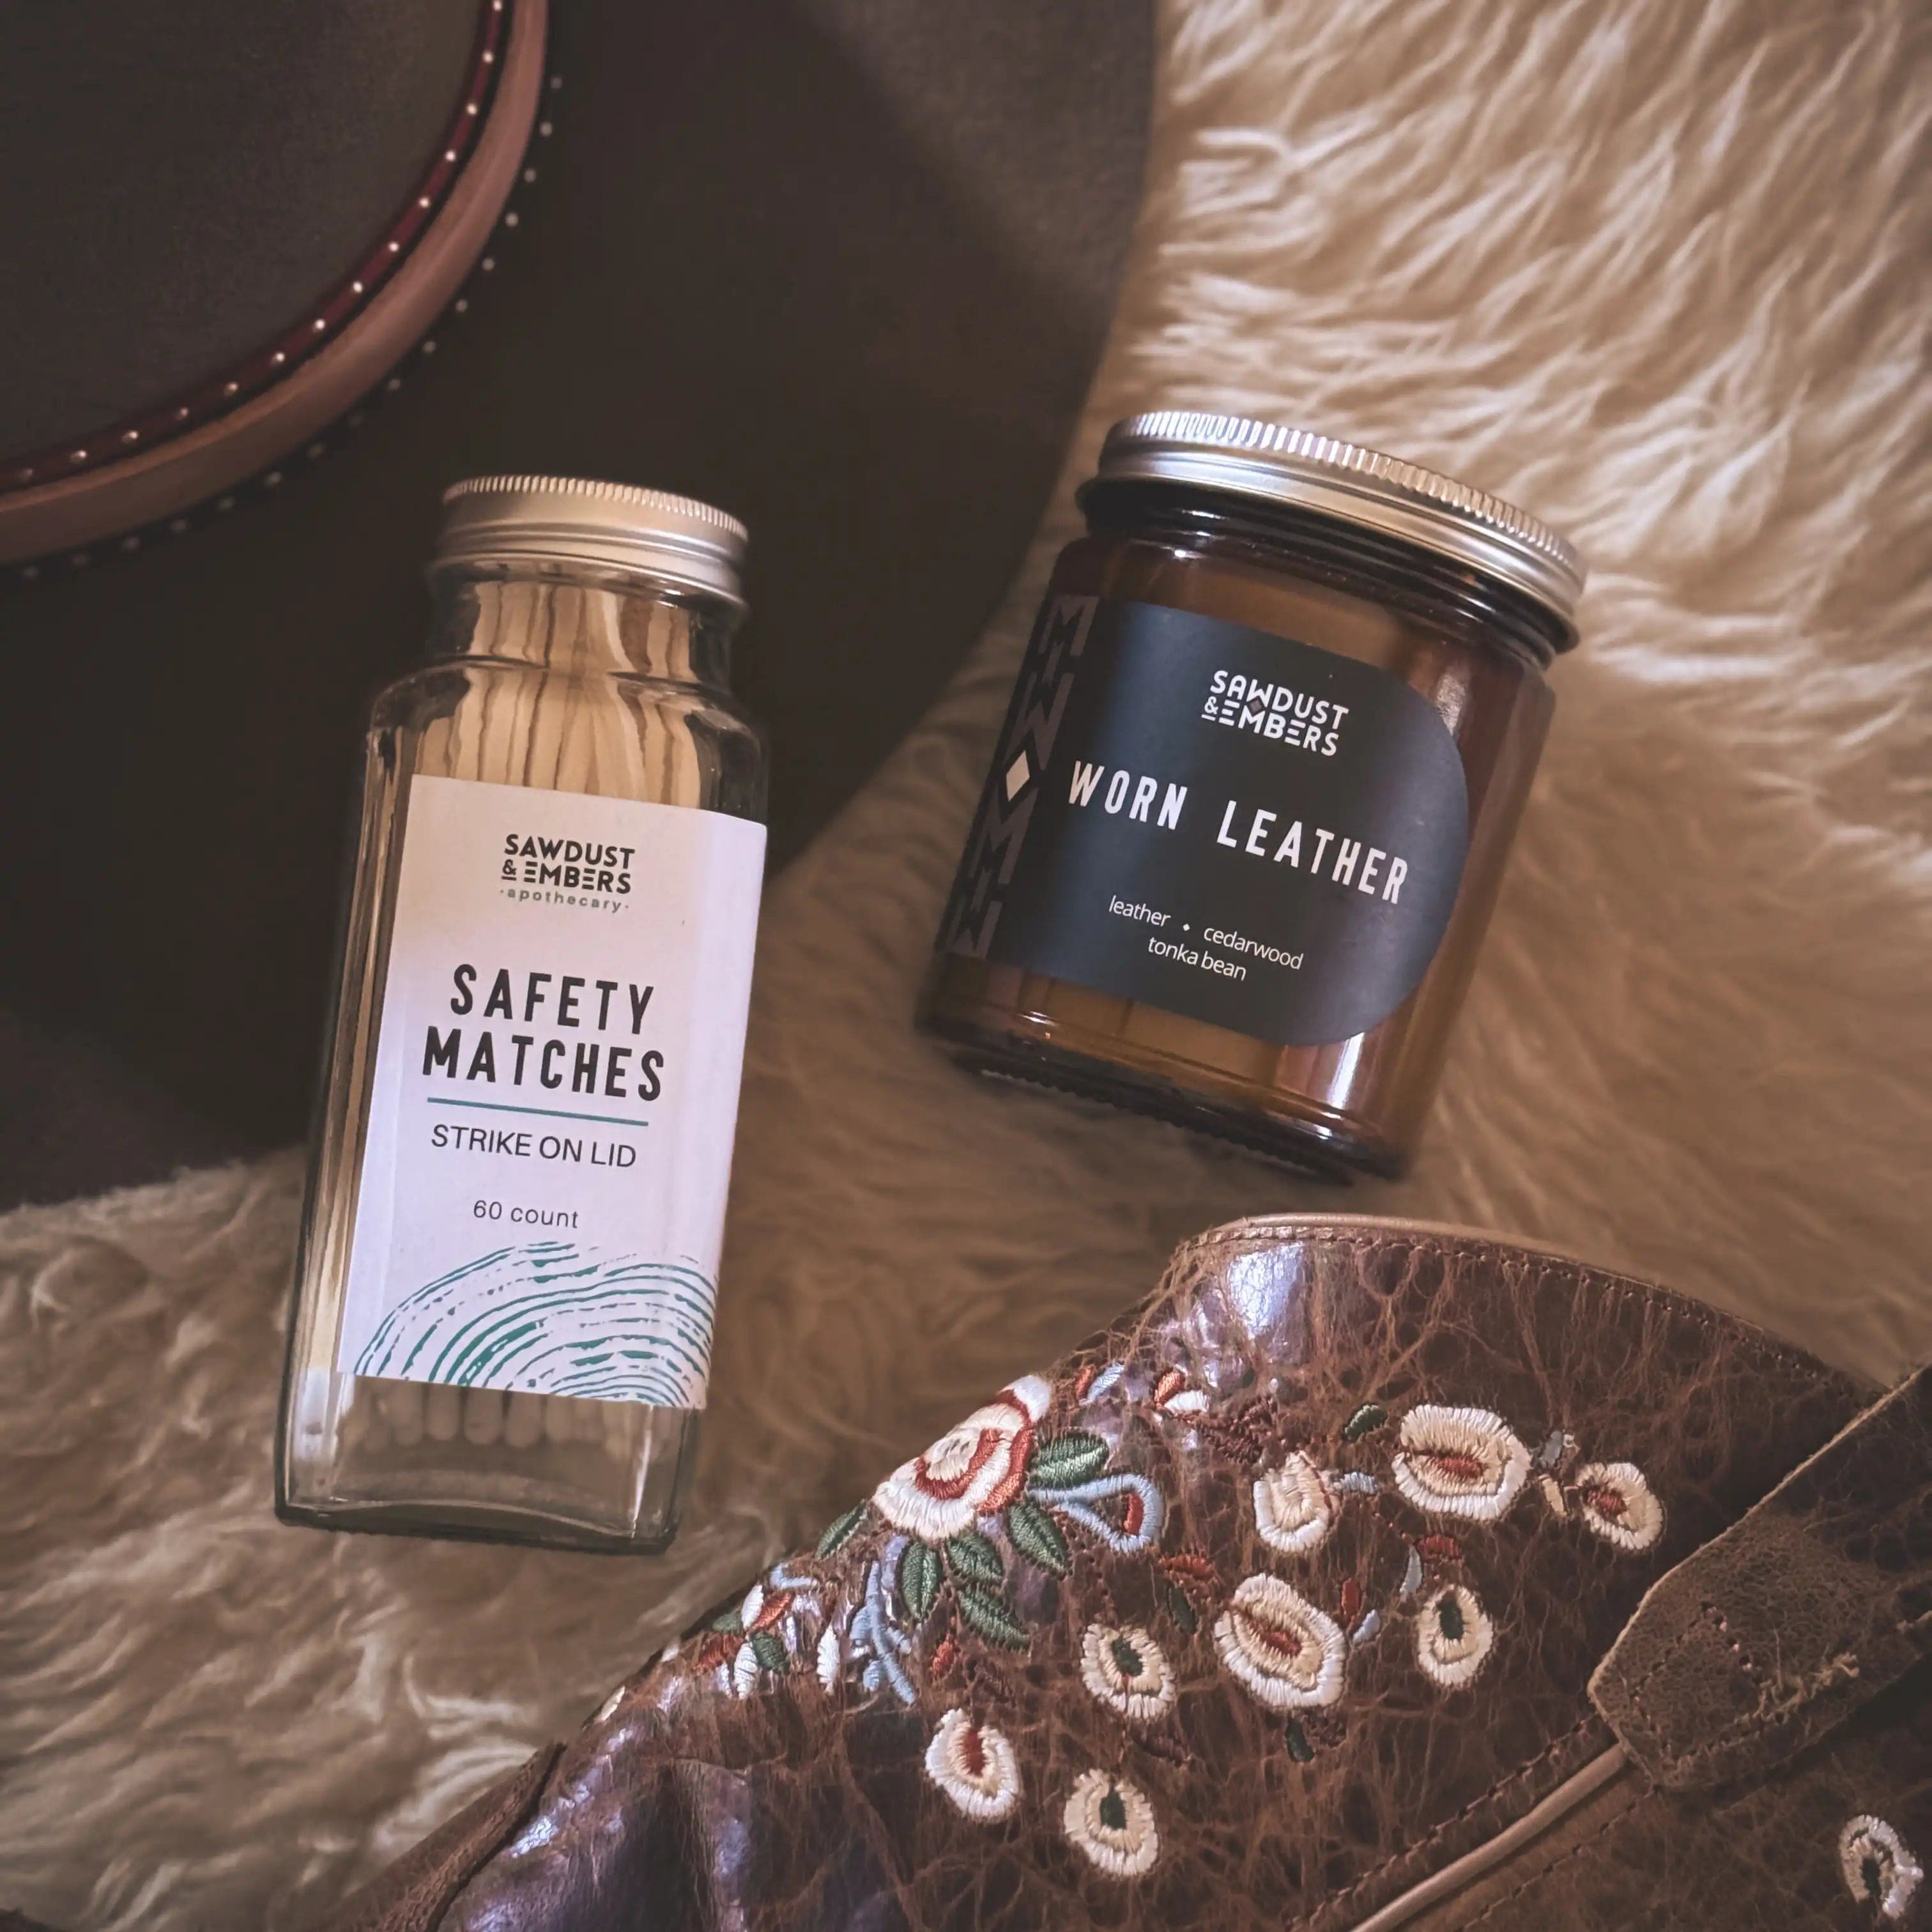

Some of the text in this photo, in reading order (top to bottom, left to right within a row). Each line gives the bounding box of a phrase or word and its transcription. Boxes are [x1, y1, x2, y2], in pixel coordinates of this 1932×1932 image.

[1202, 696, 1340, 756] & EMBERS
[1210, 670, 1349, 730] SAWDUST
[505, 834, 635, 869] SAWDUST
[1069, 760, 1408, 905] WORN LEATHER
[502, 859, 631, 894] & EMBERS
[1109, 895, 1303, 970] leather cedarwood
[1148, 937, 1246, 981] tonka bean
[450, 963, 654, 1034] SAFETY
[422, 1025, 664, 1101] MATCHES
[431, 1124, 636, 1167] STRIKE ON LID
[473, 1200, 578, 1228] 60 count
